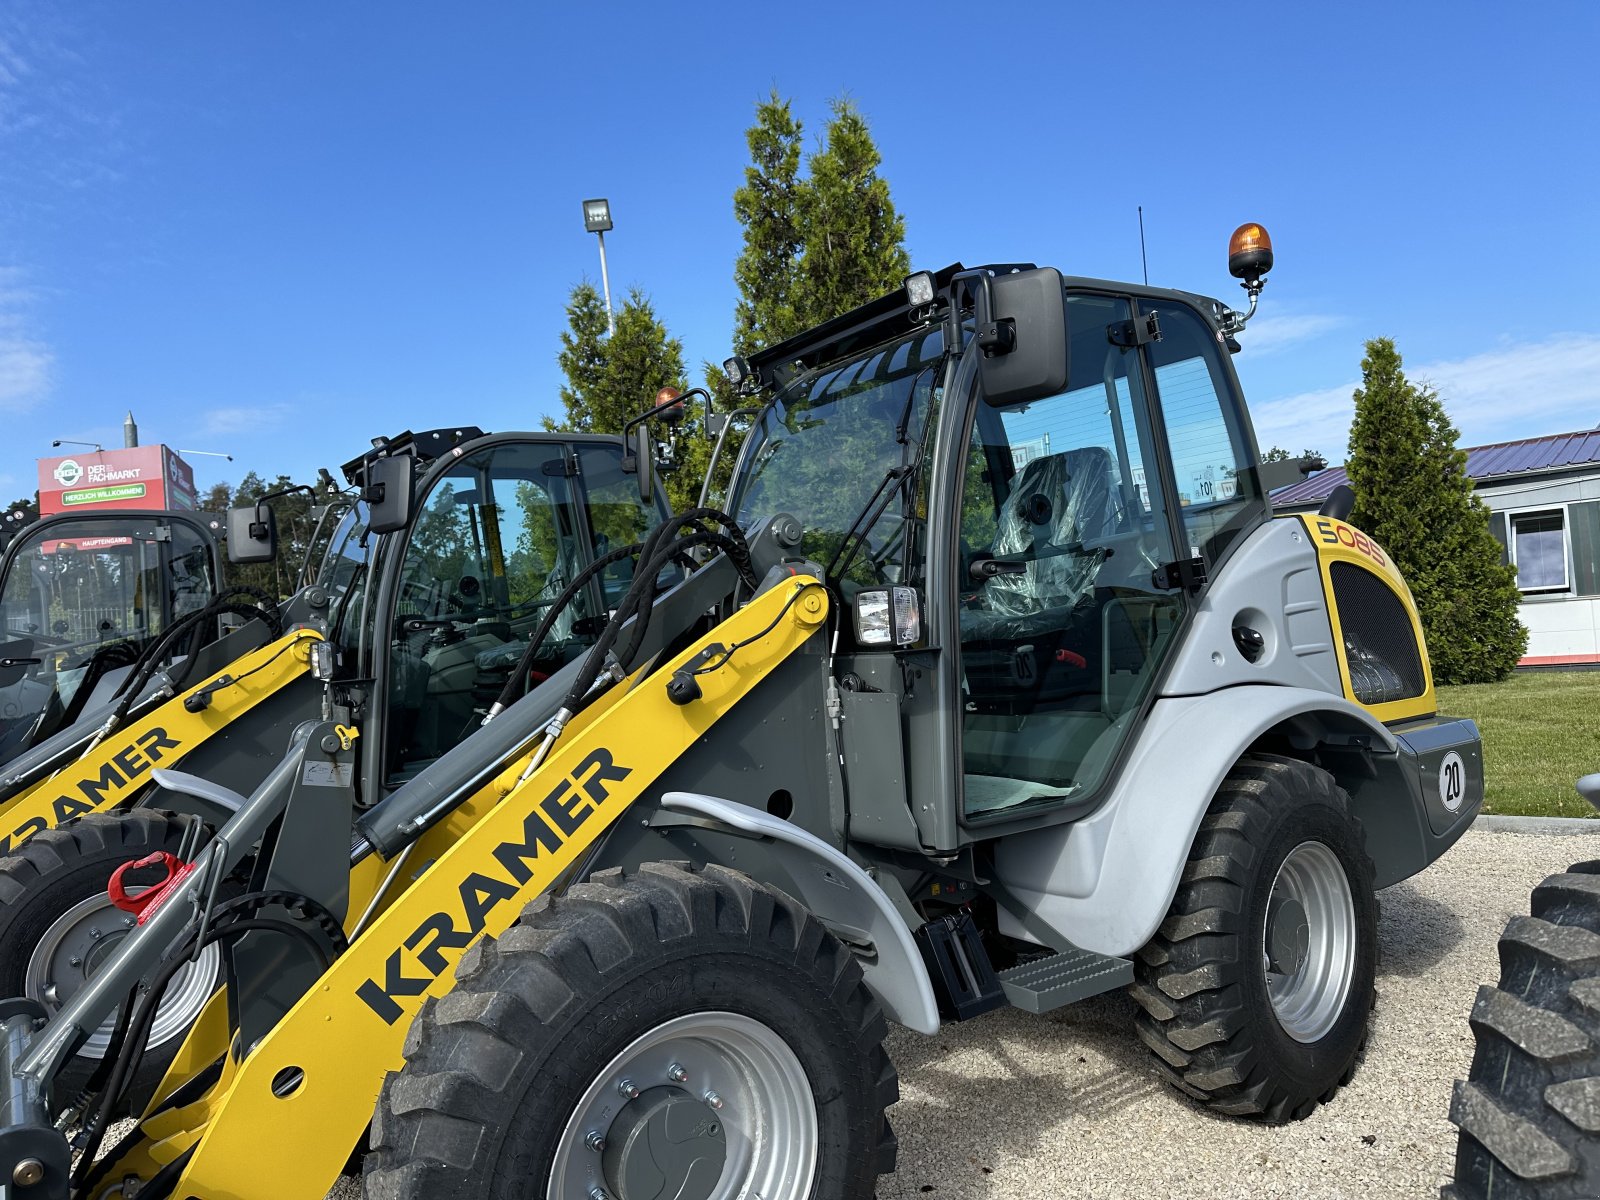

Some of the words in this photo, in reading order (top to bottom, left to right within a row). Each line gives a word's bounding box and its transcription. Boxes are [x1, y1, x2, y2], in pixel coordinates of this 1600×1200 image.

[87, 465, 105, 475] DER
[88, 468, 140, 483] FACHMARKT
[65, 491, 97, 502] HERZLICH
[82, 536, 127, 547] HAUPTEINGANG
[1316, 521, 1386, 568] 5085
[1444, 760, 1460, 802] 20
[355, 747, 633, 1026] KRAMER
